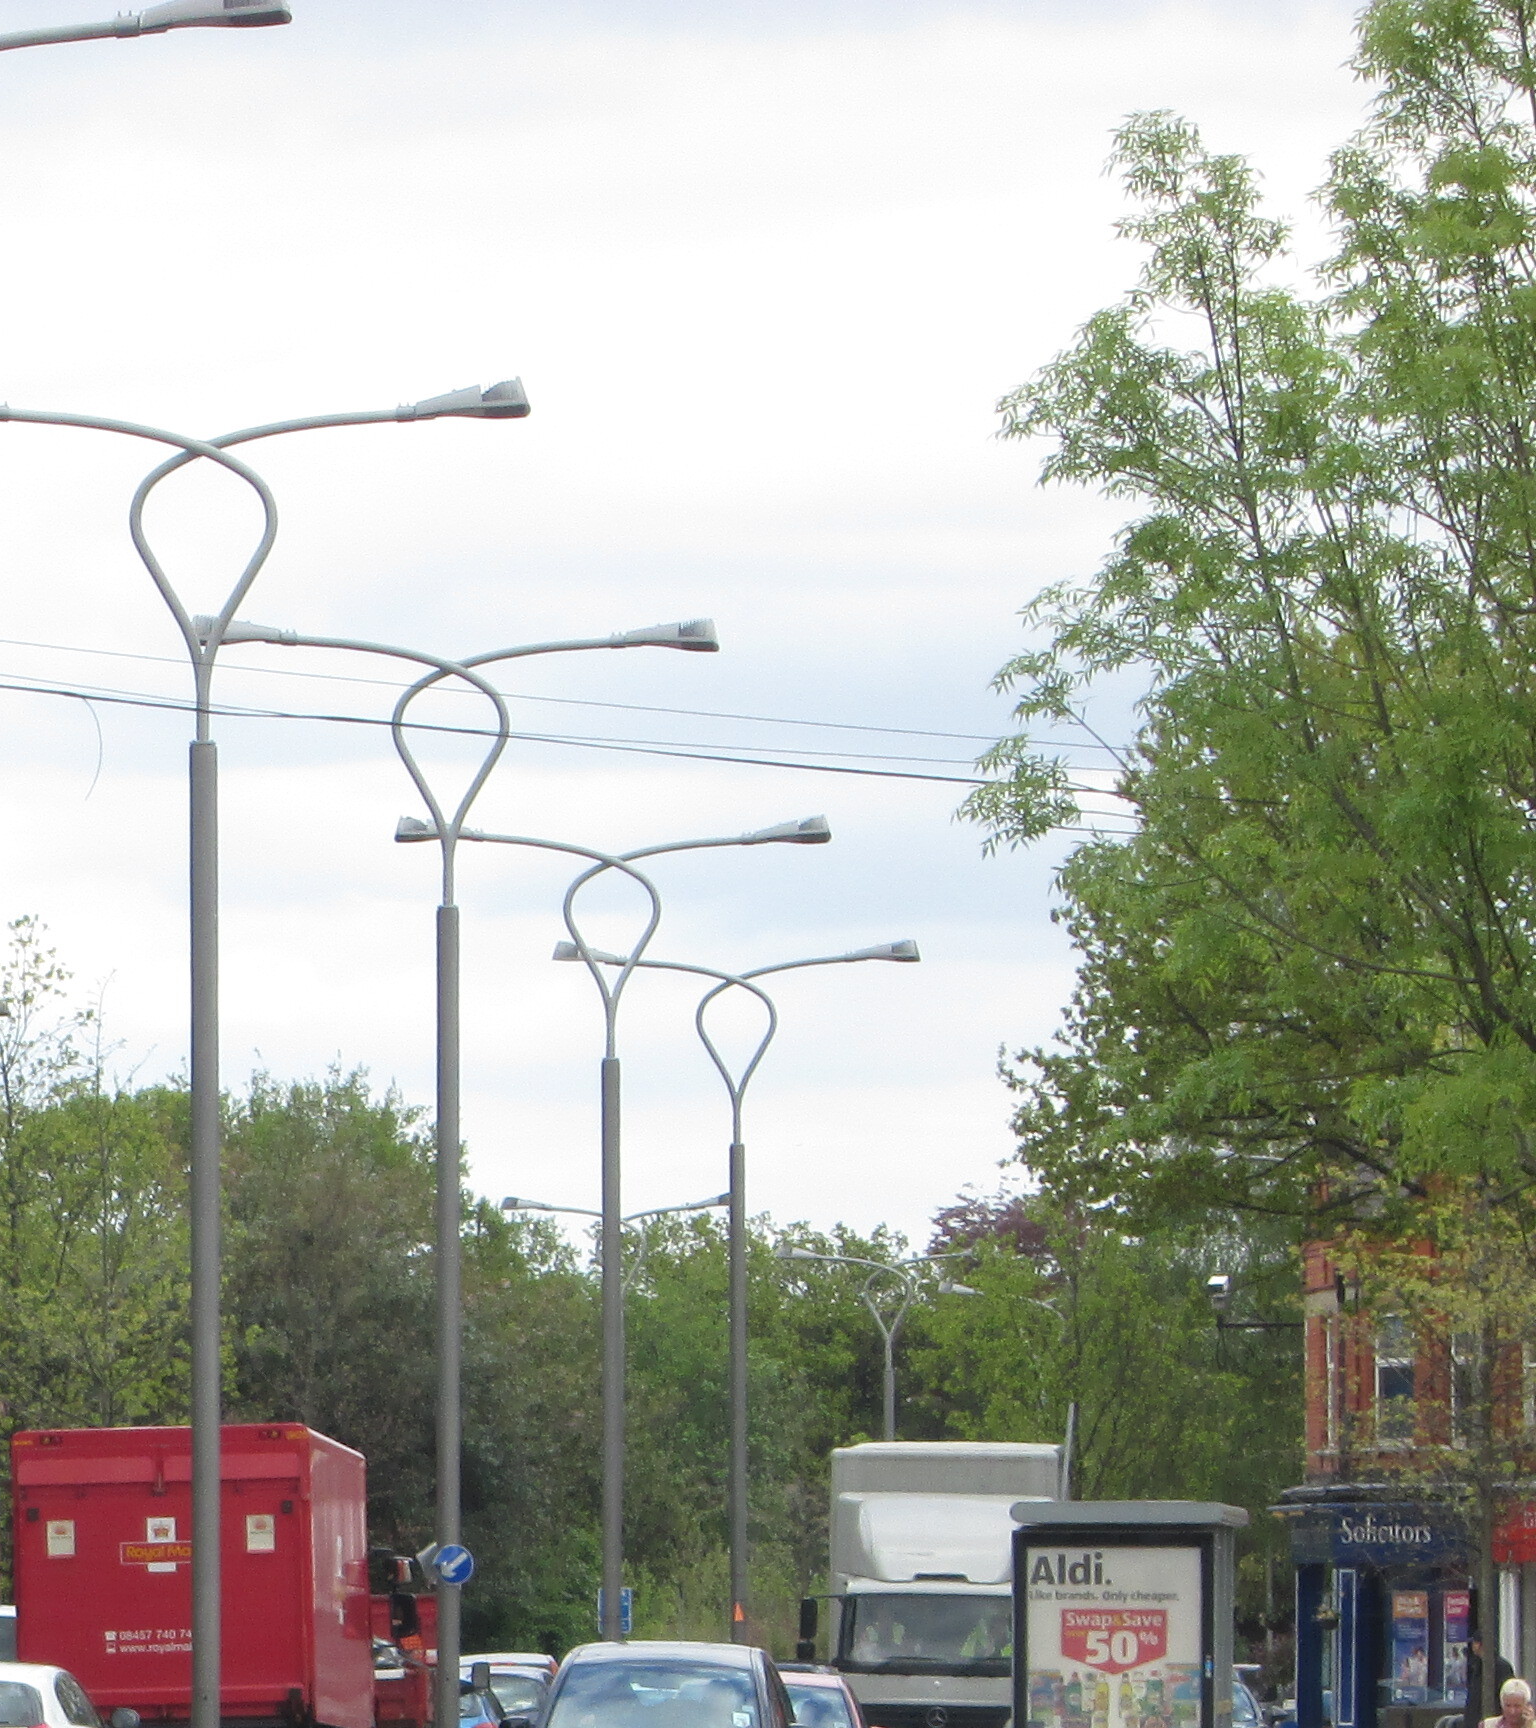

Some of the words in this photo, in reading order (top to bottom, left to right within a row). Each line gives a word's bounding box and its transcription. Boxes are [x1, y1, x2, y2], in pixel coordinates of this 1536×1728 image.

[1340, 1513, 1432, 1544] Solicitors
[126, 1544, 166, 1561] Royal
[168, 1544, 193, 1557] Ma
[1030, 1551, 1113, 1585] Aldi.
[1066, 1612, 1112, 1629] Swap
[1122, 1612, 1163, 1627] Save
[156, 1629, 177, 1640] 740
[179, 1628, 193, 1639] 74
